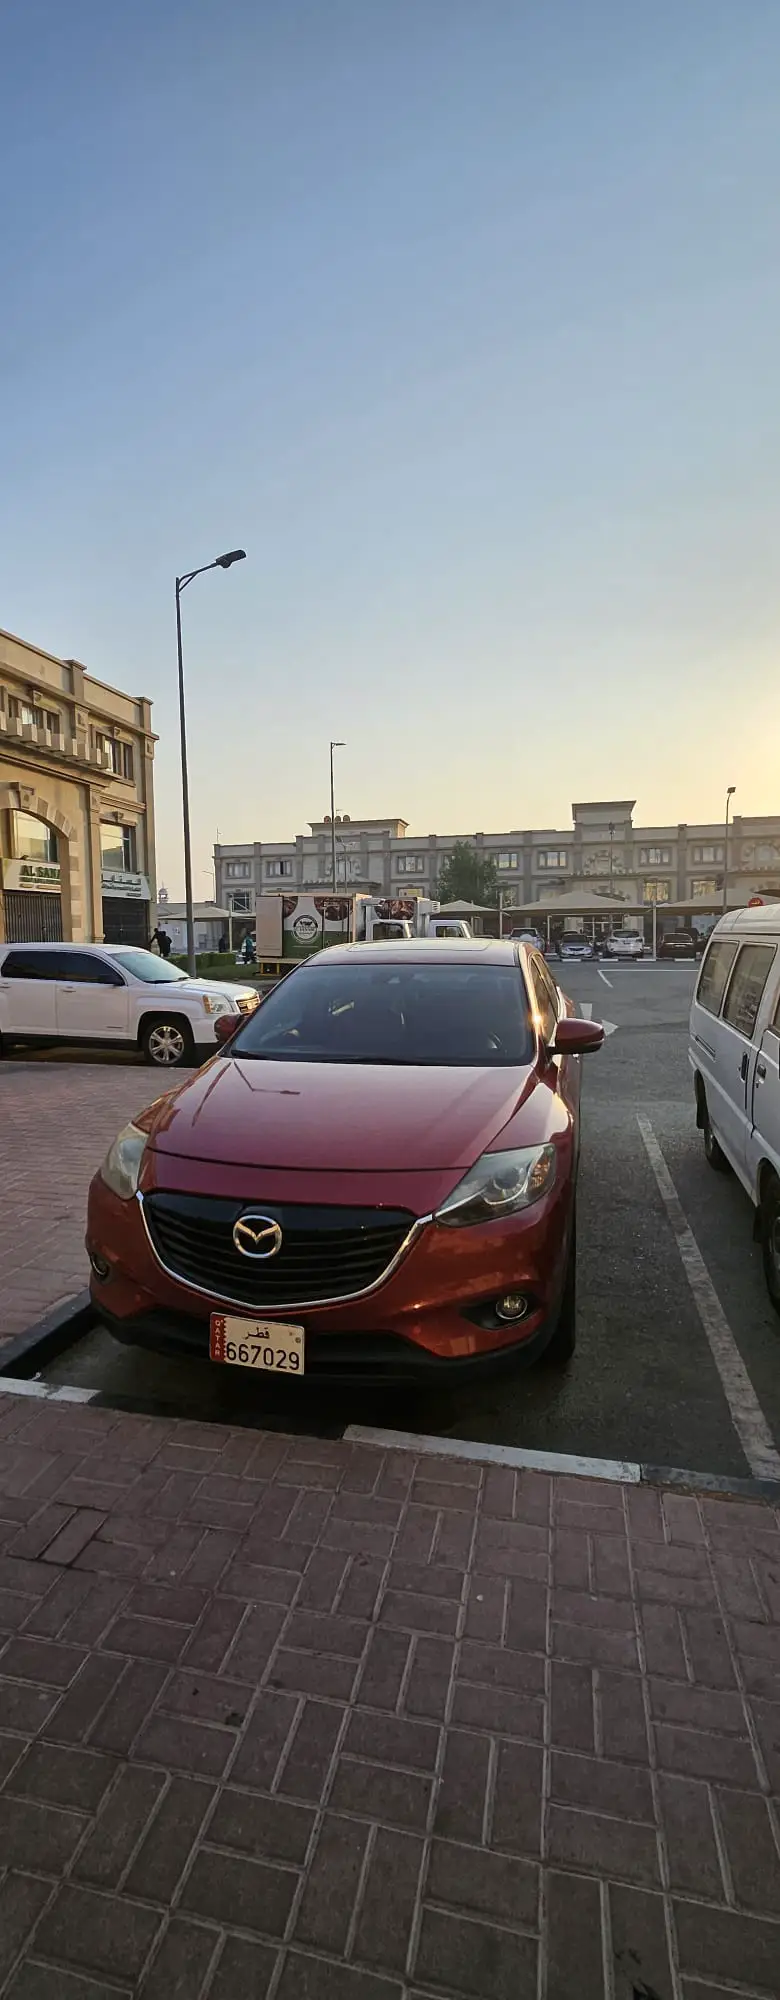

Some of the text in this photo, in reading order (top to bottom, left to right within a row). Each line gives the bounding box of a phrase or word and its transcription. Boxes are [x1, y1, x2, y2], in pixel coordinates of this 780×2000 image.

[19, 865, 35, 876] AL
[243, 1326, 271, 1340] قطر
[226, 1341, 300, 1371] 667029
